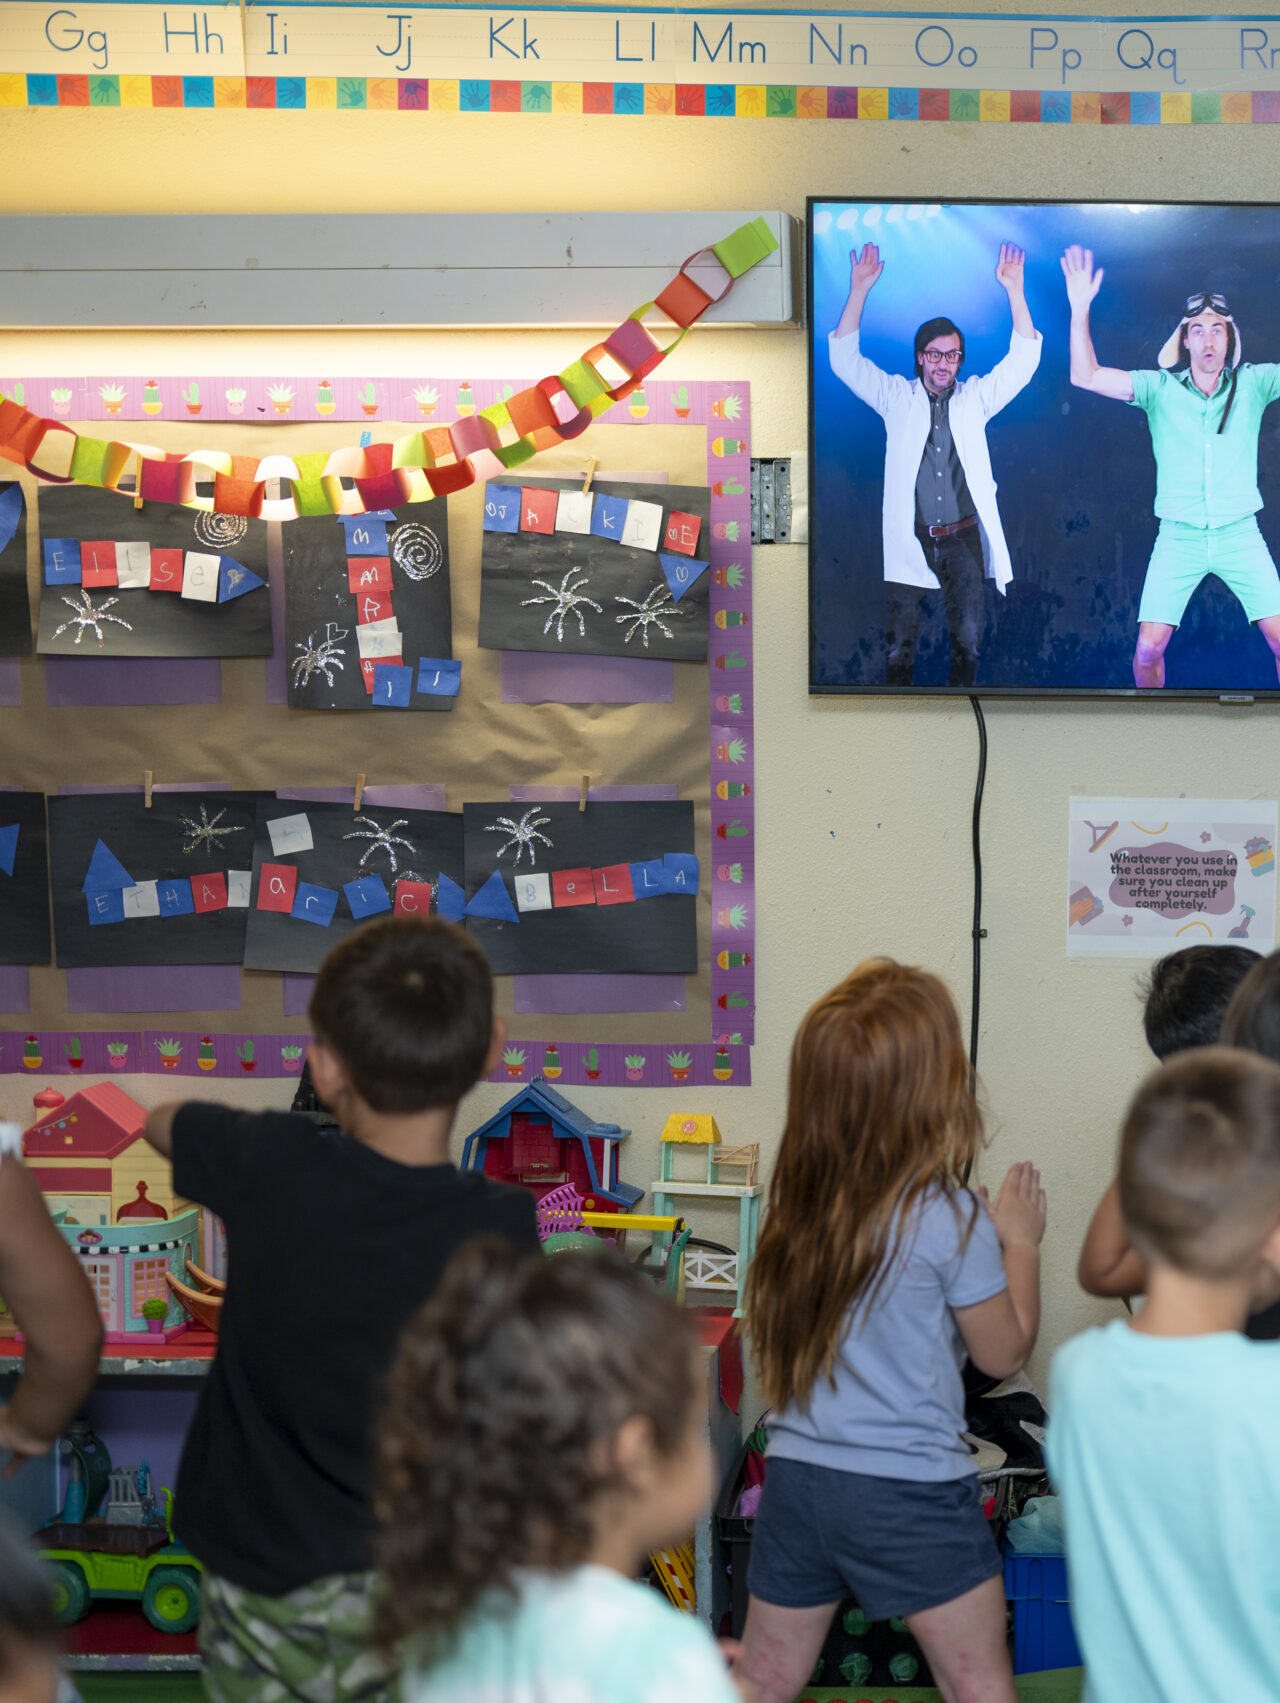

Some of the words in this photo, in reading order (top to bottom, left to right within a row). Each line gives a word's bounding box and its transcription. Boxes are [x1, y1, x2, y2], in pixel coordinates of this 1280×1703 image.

[45, 11, 108, 69] Gg
[164, 11, 223, 54] Hh
[267, 13, 288, 55] Ii
[376, 15, 412, 71] Jj
[490, 17, 540, 60] Kk
[616, 20, 656, 62] Ll
[693, 21, 766, 64] Mm
[809, 23, 868, 65] Nn
[915, 26, 978, 68] Oo
[1030, 28, 1082, 81] Pp
[1117, 29, 1186, 85] Qq
[1110, 853, 1172, 864] Whatever
[1175, 856, 1199, 867] you
[1202, 857, 1223, 865] use
[1227, 854, 1238, 866] in
[1110, 864, 1131, 875] the
[1134, 865, 1201, 877] classroom,
[1204, 866, 1237, 877] make
[1118, 877, 1145, 886] sure
[1149, 879, 1172, 889] you
[1176, 877, 1209, 887] clean
[1212, 880, 1228, 890] up
[1129, 887, 1161, 897] after
[1165, 888, 1217, 900] yourself
[1135, 899, 1207, 911] completely.
